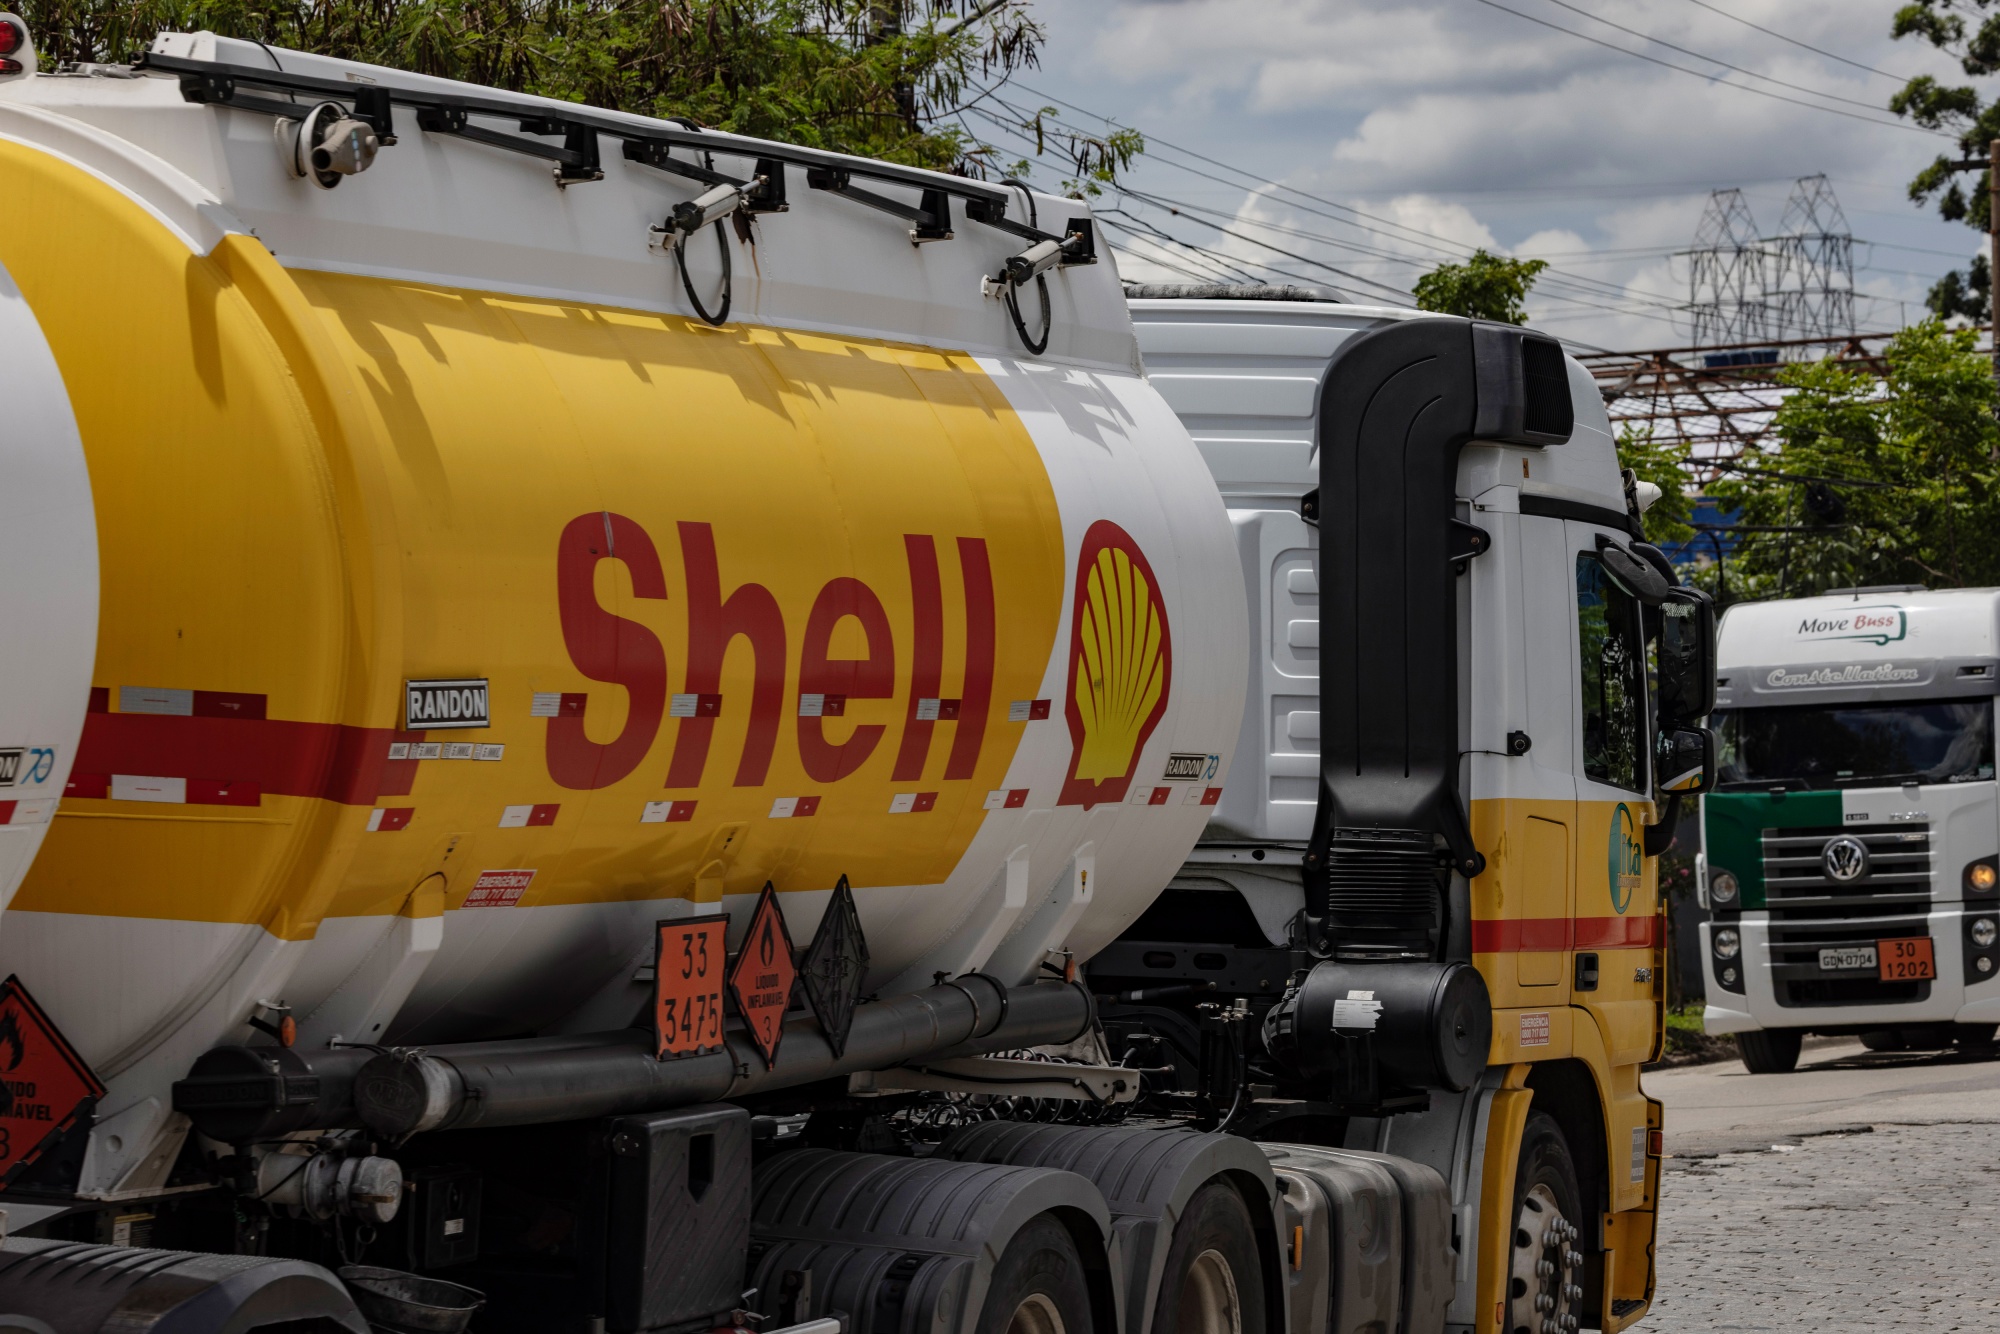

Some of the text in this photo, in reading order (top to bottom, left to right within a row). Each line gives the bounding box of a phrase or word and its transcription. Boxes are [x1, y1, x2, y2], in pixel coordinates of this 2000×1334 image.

[1798, 615, 1894, 635] Move Buss
[545, 511, 996, 790] Shell
[1766, 663, 1919, 687] Constellation
[409, 688, 486, 719] RANDON
[1166, 758, 1204, 775] RANDON
[475, 872, 531, 888] EMERGÊNCIA
[468, 888, 491, 900] 0800
[486, 888, 505, 900] 717
[681, 932, 708, 979] 33
[1895, 942, 1916, 958] 30
[1823, 954, 1873, 967] GDN-0704
[1887, 961, 1929, 978] 1202
[664, 993, 719, 1044] 3475
[1521, 1014, 1549, 1028] EMERGÊNCIA
[763, 1016, 772, 1044] 3
[1521, 1028, 1532, 1038] 0800
[5, 1080, 36, 1098] IDO
